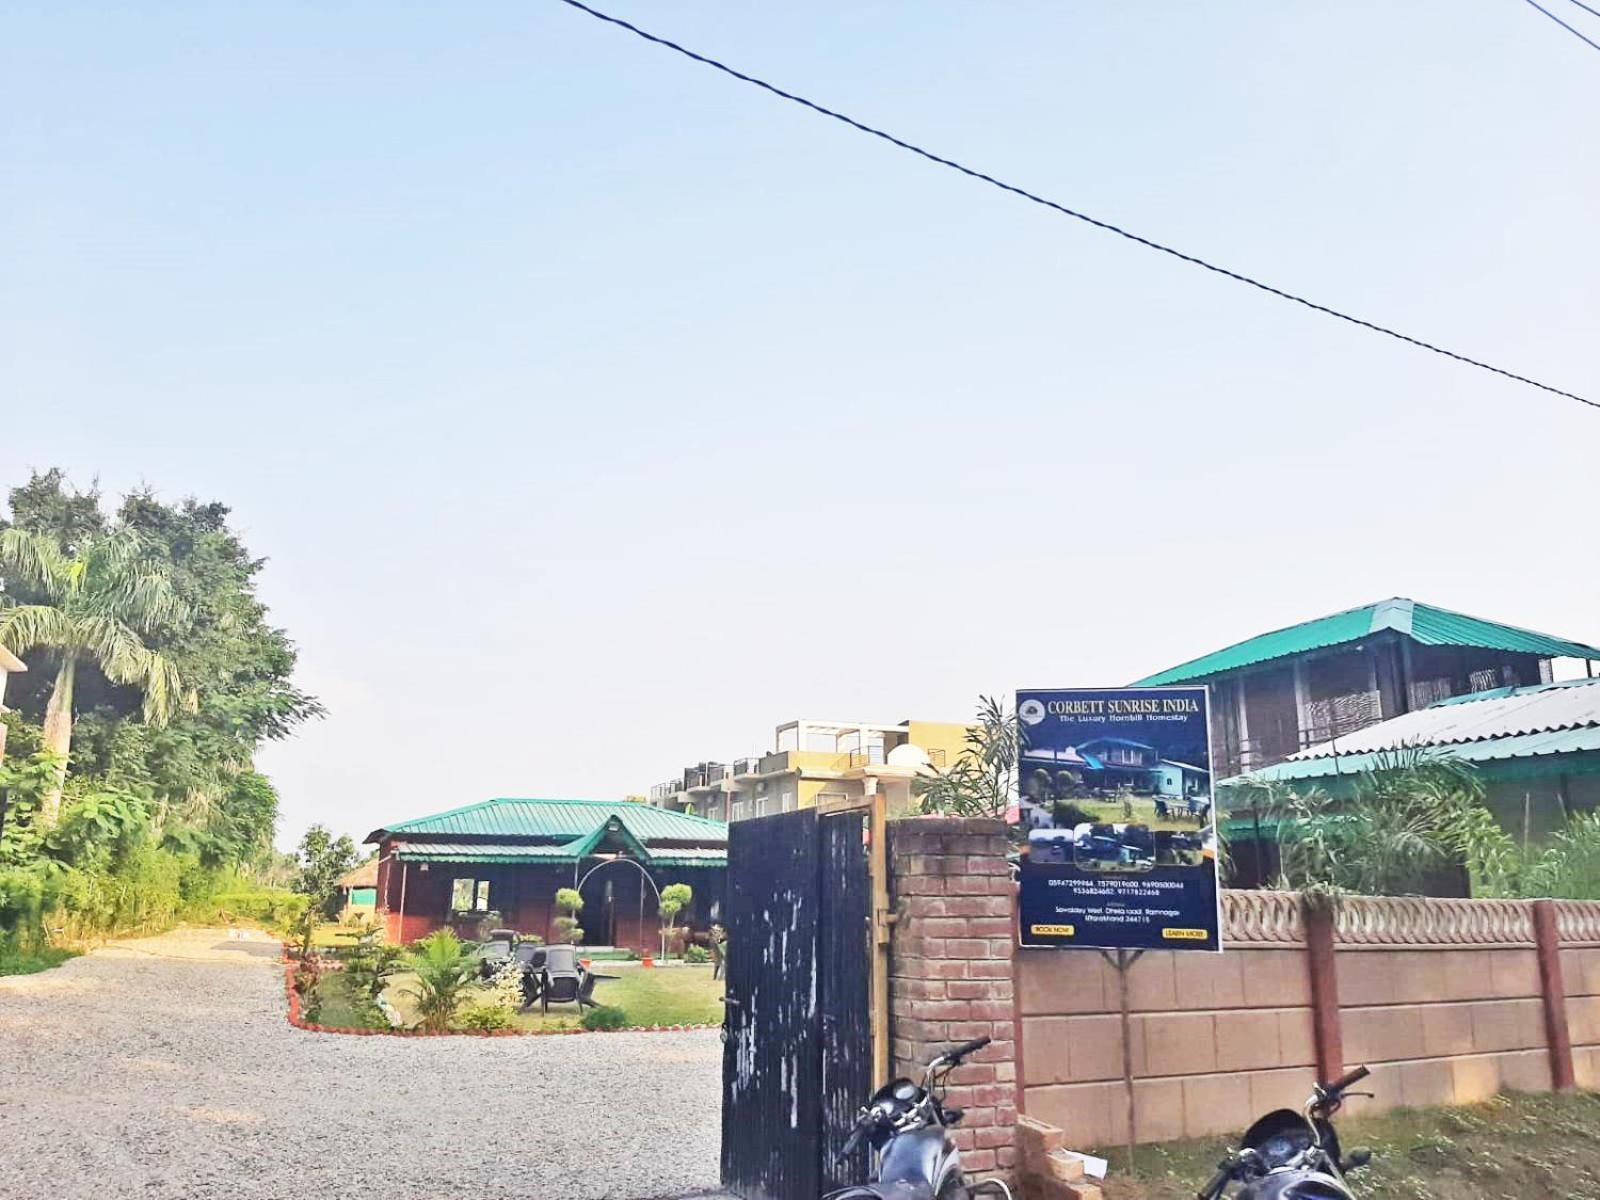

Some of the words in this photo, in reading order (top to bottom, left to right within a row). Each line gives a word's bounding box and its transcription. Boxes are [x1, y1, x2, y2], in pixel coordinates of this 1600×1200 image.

[1048, 700, 1105, 714] CORBETT
[1108, 699, 1160, 714] SUNRISE
[1163, 699, 1199, 713] INDIA
[1078, 715, 1106, 723] Luxury
[1109, 714, 1143, 722] Hornbill
[1146, 714, 1188, 723] Homestay
